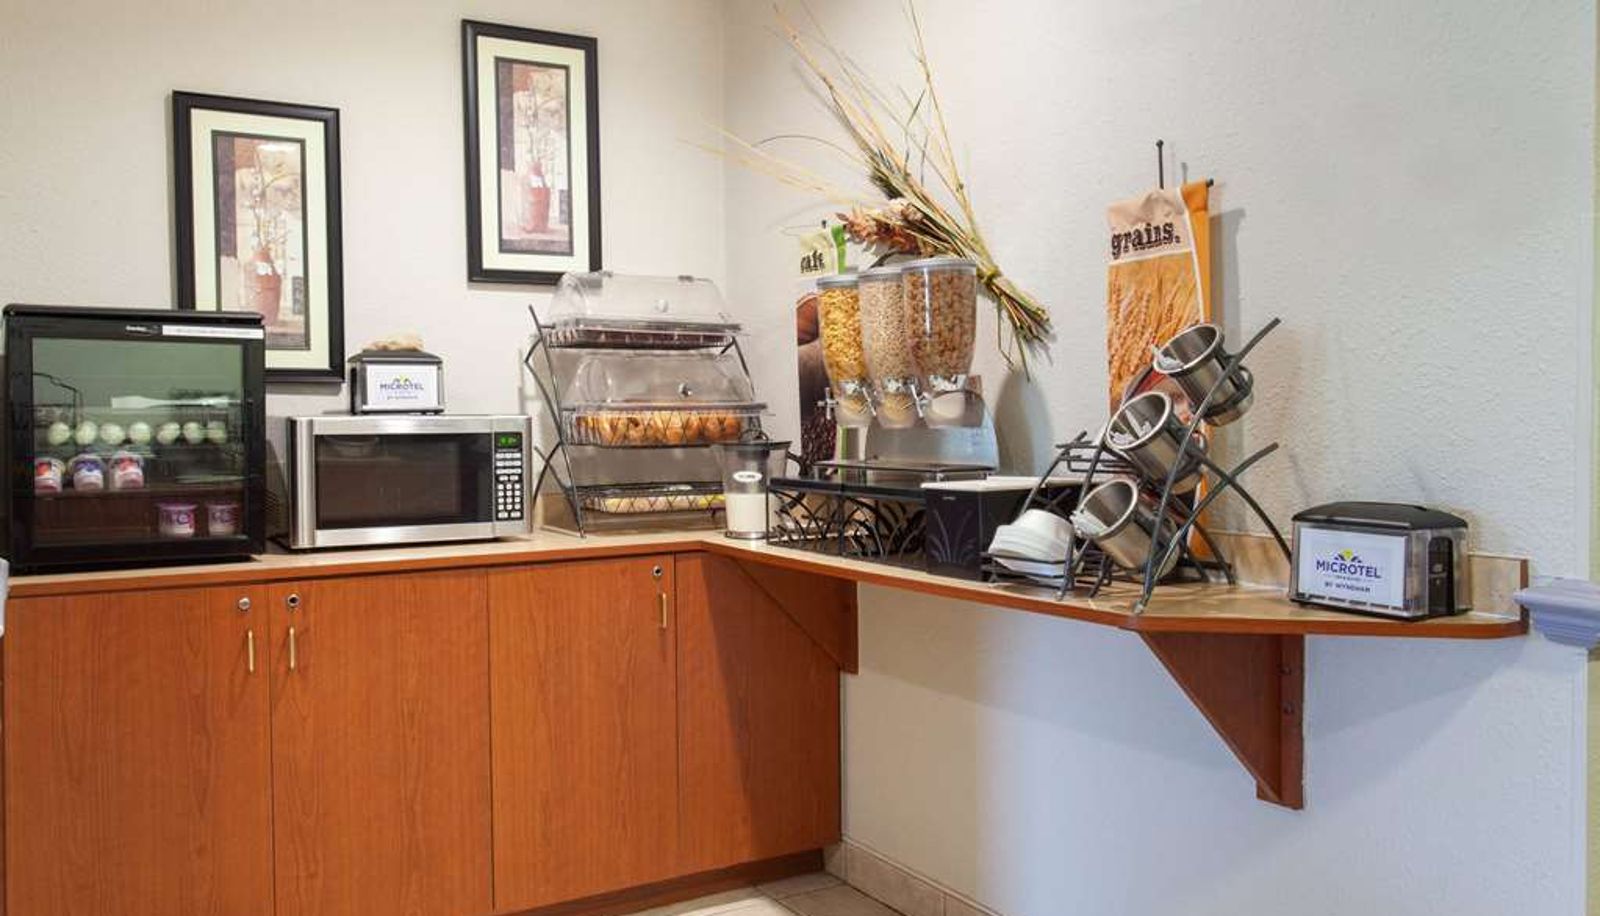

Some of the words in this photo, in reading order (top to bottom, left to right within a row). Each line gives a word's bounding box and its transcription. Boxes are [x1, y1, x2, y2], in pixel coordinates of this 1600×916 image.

[1111, 222, 1181, 260] grains.
[379, 383, 425, 391] MICROTEL
[1316, 560, 1382, 579] MICROTEL
